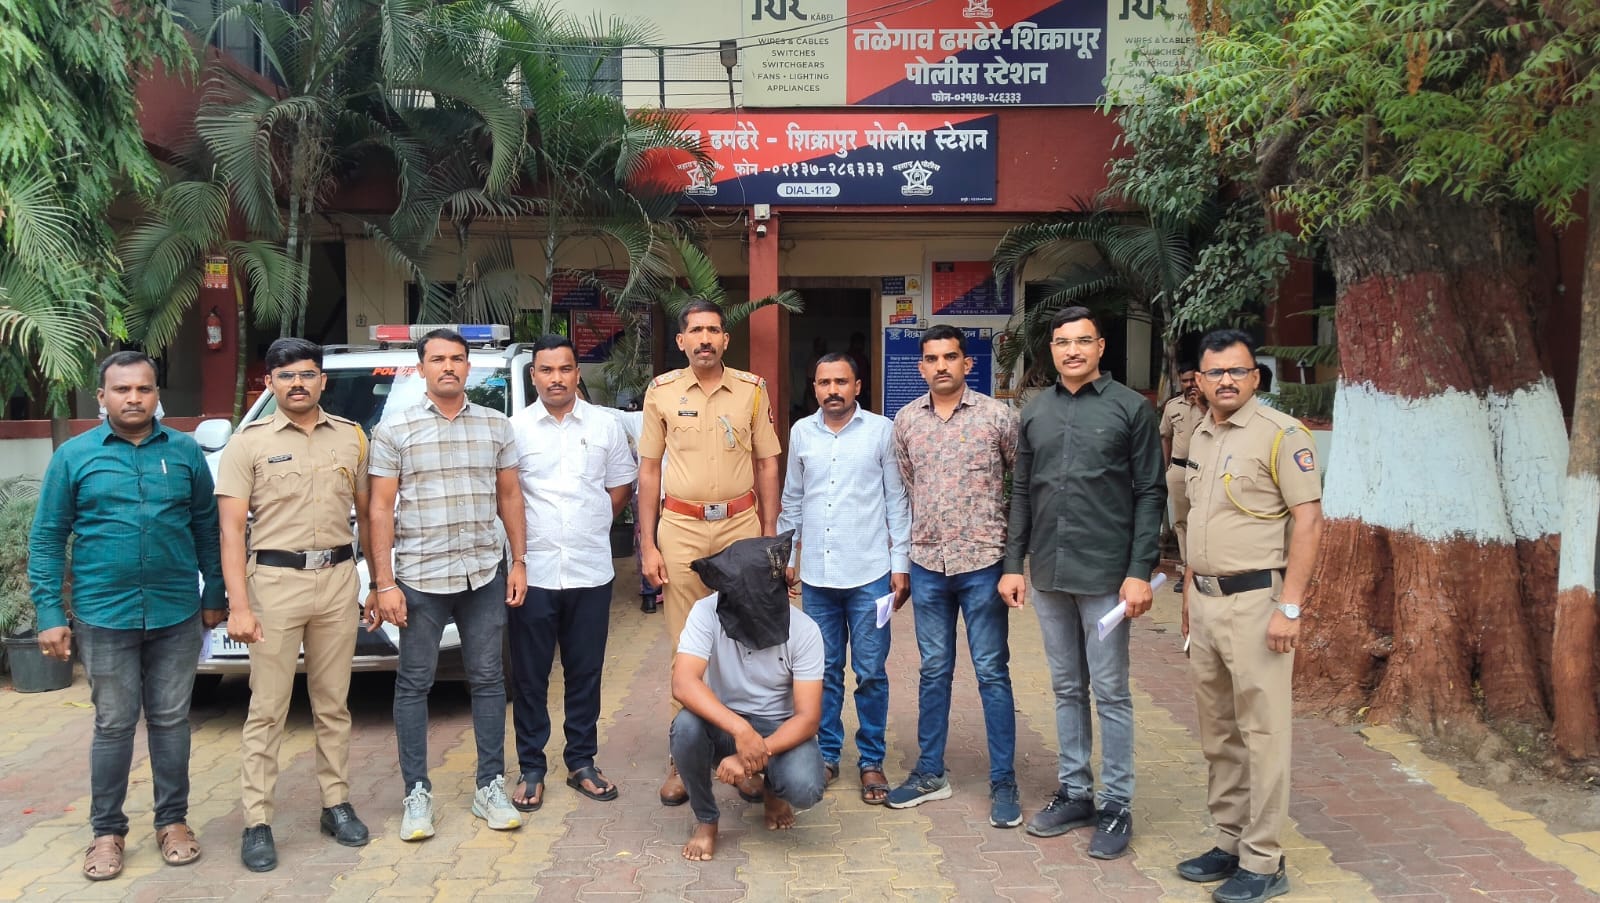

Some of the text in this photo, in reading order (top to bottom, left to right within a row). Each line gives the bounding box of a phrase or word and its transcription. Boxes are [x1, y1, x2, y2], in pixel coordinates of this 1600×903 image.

[853, 22, 935, 50] तळेगाव
[762, 61, 825, 69] SWITCHGEARS
[905, 55, 1048, 84] पोलीस स्टेशन
[767, 84, 820, 92] APPLIANCES
[708, 121, 759, 150] ढमढेरे
[786, 122, 857, 158] शिक्रापुर
[865, 121, 927, 150] पोलीस
[934, 121, 988, 152] स्टेशन
[734, 158, 758, 176] फोन
[785, 185, 832, 195] DIAL-112
